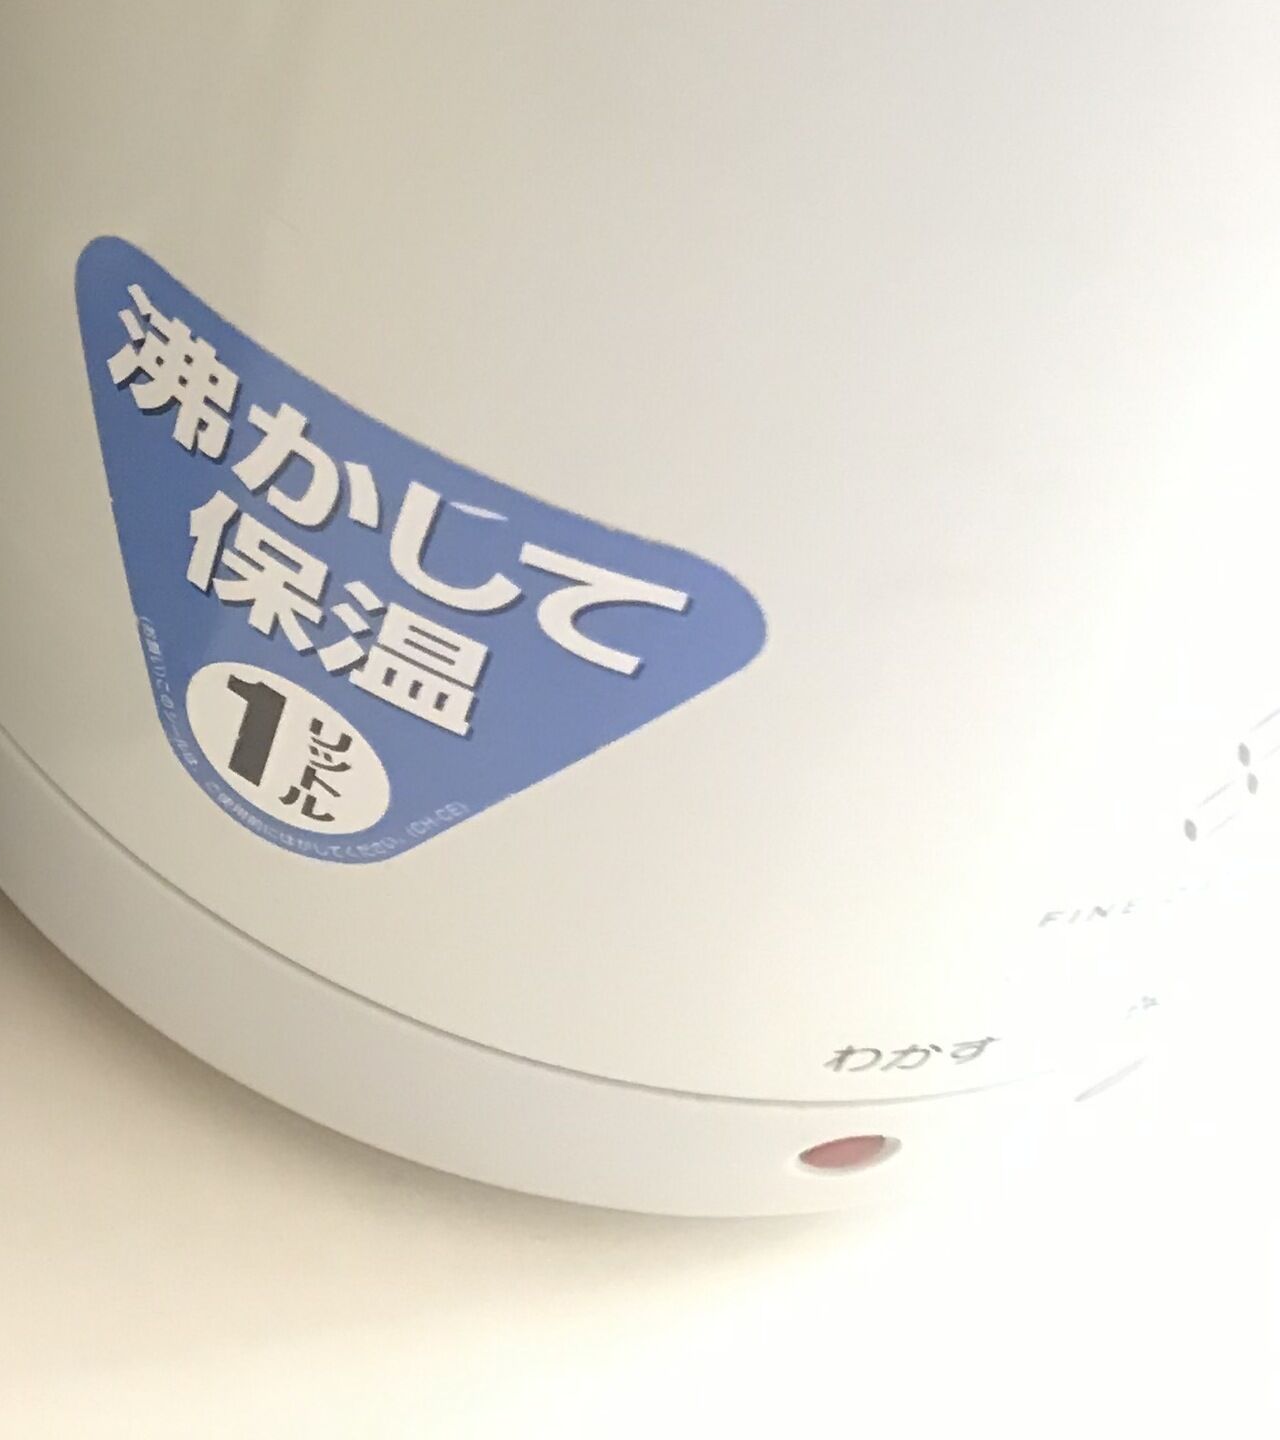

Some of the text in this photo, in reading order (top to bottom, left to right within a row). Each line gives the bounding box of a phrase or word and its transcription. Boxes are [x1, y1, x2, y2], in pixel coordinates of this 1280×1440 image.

[106, 282, 692, 678] 沸かして
[185, 489, 490, 739] 保温
[822, 1036, 1003, 1073] わかす
